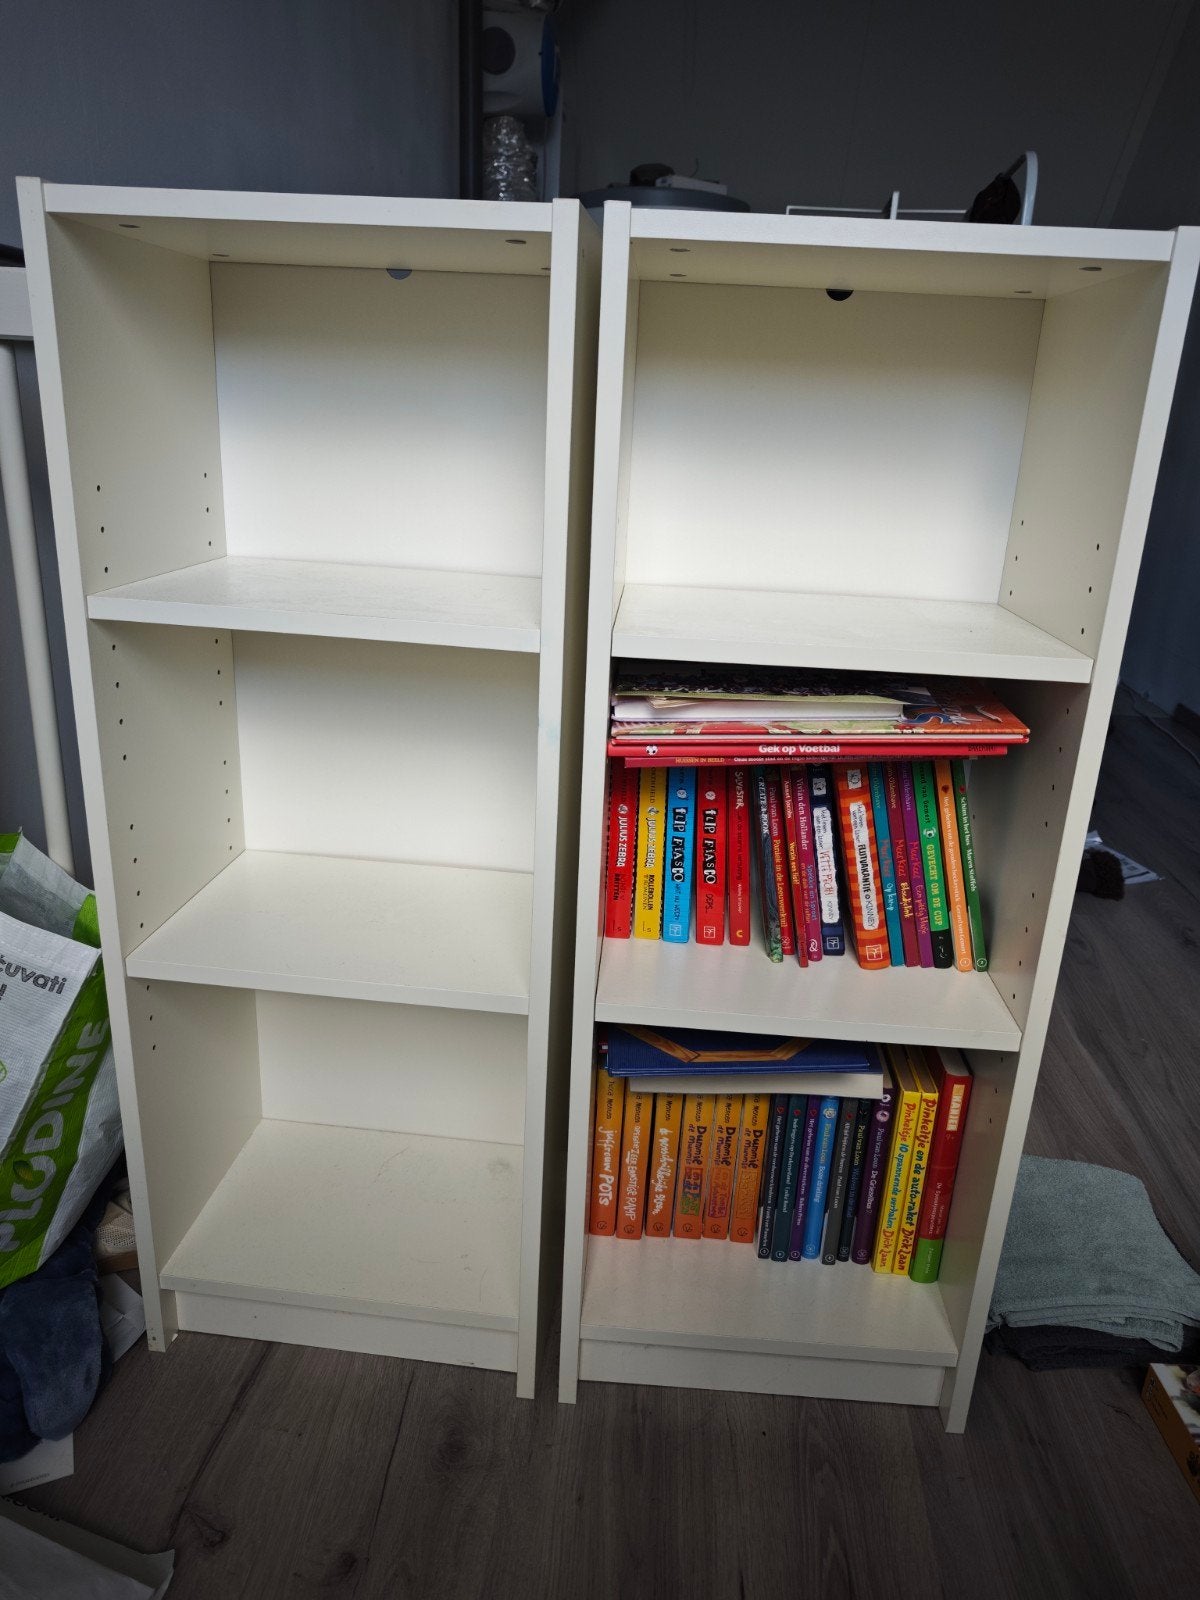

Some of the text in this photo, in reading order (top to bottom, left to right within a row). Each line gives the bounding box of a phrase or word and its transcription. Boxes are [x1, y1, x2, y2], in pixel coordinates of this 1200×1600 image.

[759, 744, 840, 755] Gek op Voetbal
[769, 787, 777, 803] Paul
[796, 778, 809, 851] Vivian den Hollander
[923, 800, 931, 824] Gemert
[960, 797, 968, 816] Schim
[771, 819, 779, 837] Loon
[616, 816, 628, 867] JULIUS ZEBRA
[645, 818, 656, 868] JULIUS ZEBRA
[895, 839, 905, 860] Mees
[909, 841, 920, 861] Mees
[948, 840, 954, 848] de
[773, 839, 782, 864] Paniek
[966, 849, 974, 868] Maren
[776, 864, 783, 872] in
[898, 860, 907, 878] Kees
[912, 861, 922, 879] Kees
[926, 844, 939, 881] GEVECHT
[776, 873, 783, 882] de
[858, 844, 876, 928] FLUTVAKANTIE KINNEY
[968, 869, 977, 893] Stoffels
[930, 883, 940, 895] OM
[778, 883, 788, 927] Leeuwenkuil
[933, 897, 942, 908] DE
[934, 910, 944, 926] CUP
[0, 1018, 110, 1251] PLODINE
[688, 1123, 696, 1132] de
[717, 1125, 724, 1134] de
[824, 1123, 832, 1137] Paul
[857, 1125, 866, 1138] Paul
[876, 1128, 885, 1141] Paul
[597, 1126, 618, 1173] juffrouw
[685, 1135, 696, 1165] Mummie
[692, 1125, 707, 1165] Dummie
[714, 1136, 724, 1166] Mummie
[721, 1126, 736, 1166] Dummie
[742, 1128, 752, 1169] de Mummie
[748, 1129, 763, 1169] Dummie
[820, 1149, 828, 1164] Loon
[853, 1150, 861, 1166] Loon
[872, 1154, 881, 1169] Loon
[871, 1170, 878, 1179] De
[866, 1179, 877, 1209] Griezelbus
[879, 1102, 916, 1267] Pinkeltje 10 spannende verhalen Dick Laan
[897, 1098, 938, 1271] Pinkeltje en de auto-raket Dick Laan
[623, 1196, 637, 1221] RAMP
[833, 1196, 841, 1209] Loon
